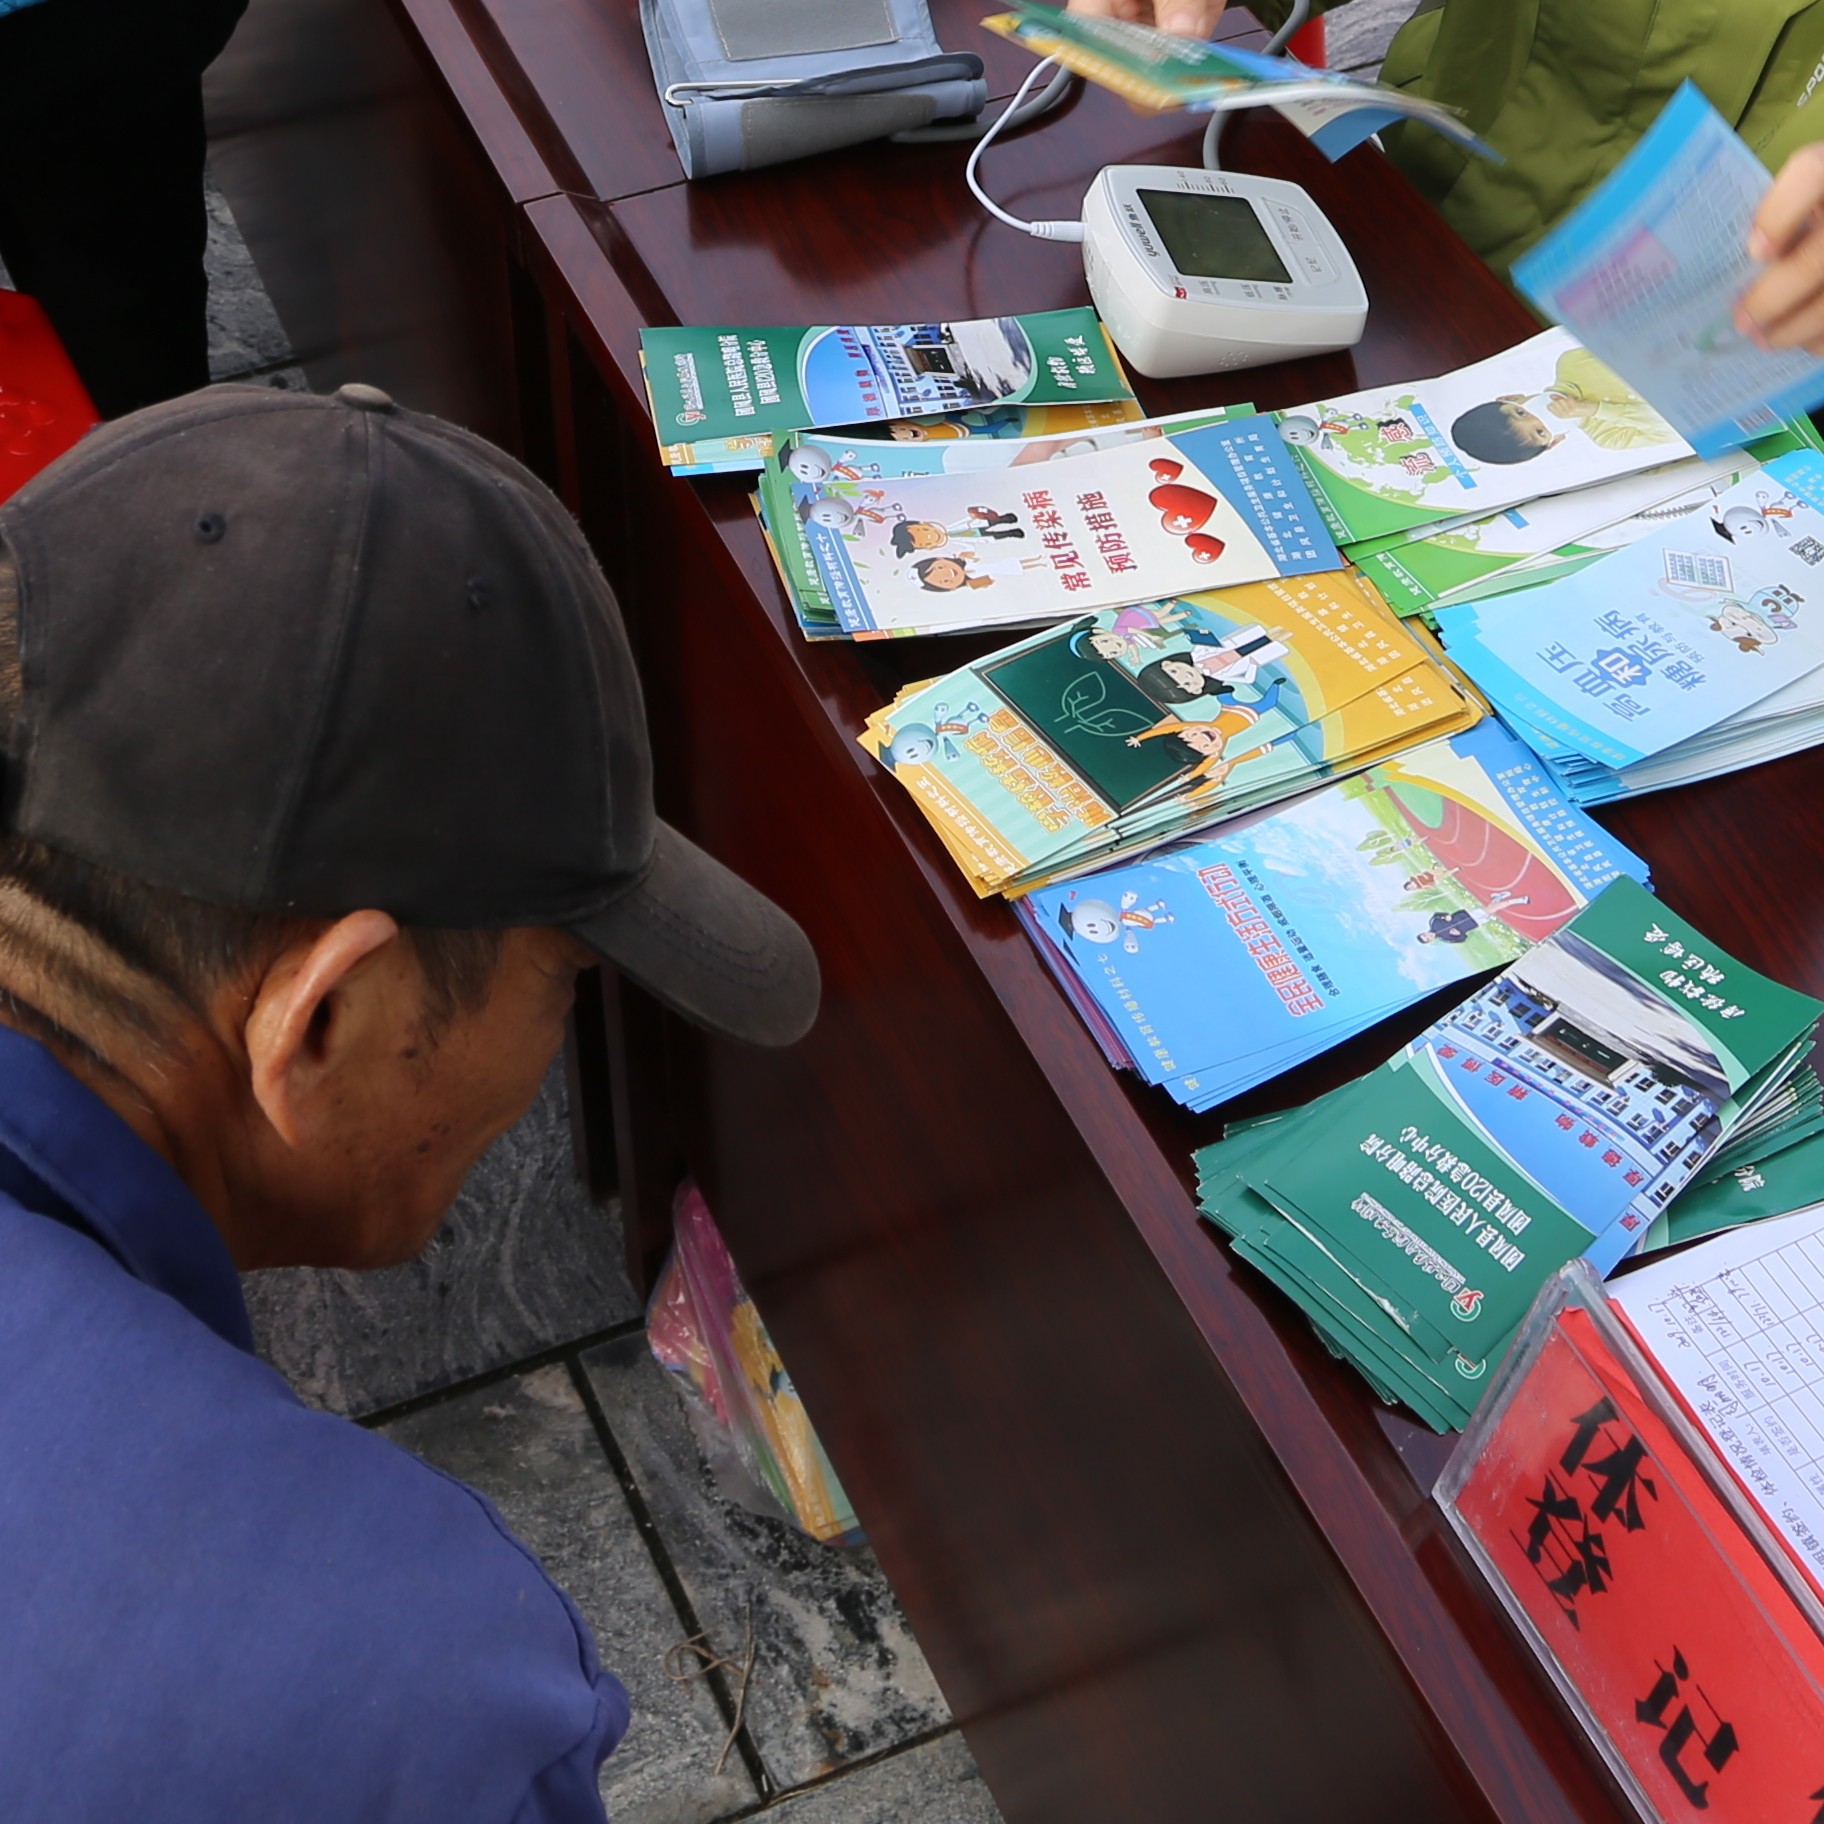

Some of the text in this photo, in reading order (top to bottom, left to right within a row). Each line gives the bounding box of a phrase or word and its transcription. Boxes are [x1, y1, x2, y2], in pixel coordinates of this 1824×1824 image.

[1380, 419, 1436, 478] 流感
[1415, 412, 1468, 478] 个人预防知识
[1021, 488, 1092, 592] 常见传染病
[1075, 490, 1138, 574] 预防措施
[815, 532, 860, 627] 健康教育传播材料之十
[1593, 607, 1708, 692] 糖尿病
[1597, 643, 1644, 690] 和
[1634, 611, 1704, 665] 预防与教育
[1535, 639, 1650, 722] 高血压
[964, 728, 1071, 834] 学校结核病
[986, 705, 1114, 828] 防治核心信息
[1195, 861, 1324, 1018] 全民健康生活方式行动
[1236, 858, 1340, 998] 合理膳食 适量运动 戒烟限酒 心理平衡
[1095, 952, 1176, 1072] 健康教育传播材料之七
[1395, 1120, 1532, 1236] 团风县120急救分中心
[1553, 1109, 1646, 1188] 厚德载物
[1357, 1131, 1527, 1272] 团风县人民医院总路咀分院
[1682, 1312, 1705, 1337] 备注
[1718, 1357, 1756, 1401] 服务时间
[1763, 1413, 1801, 1458] 是否签约
